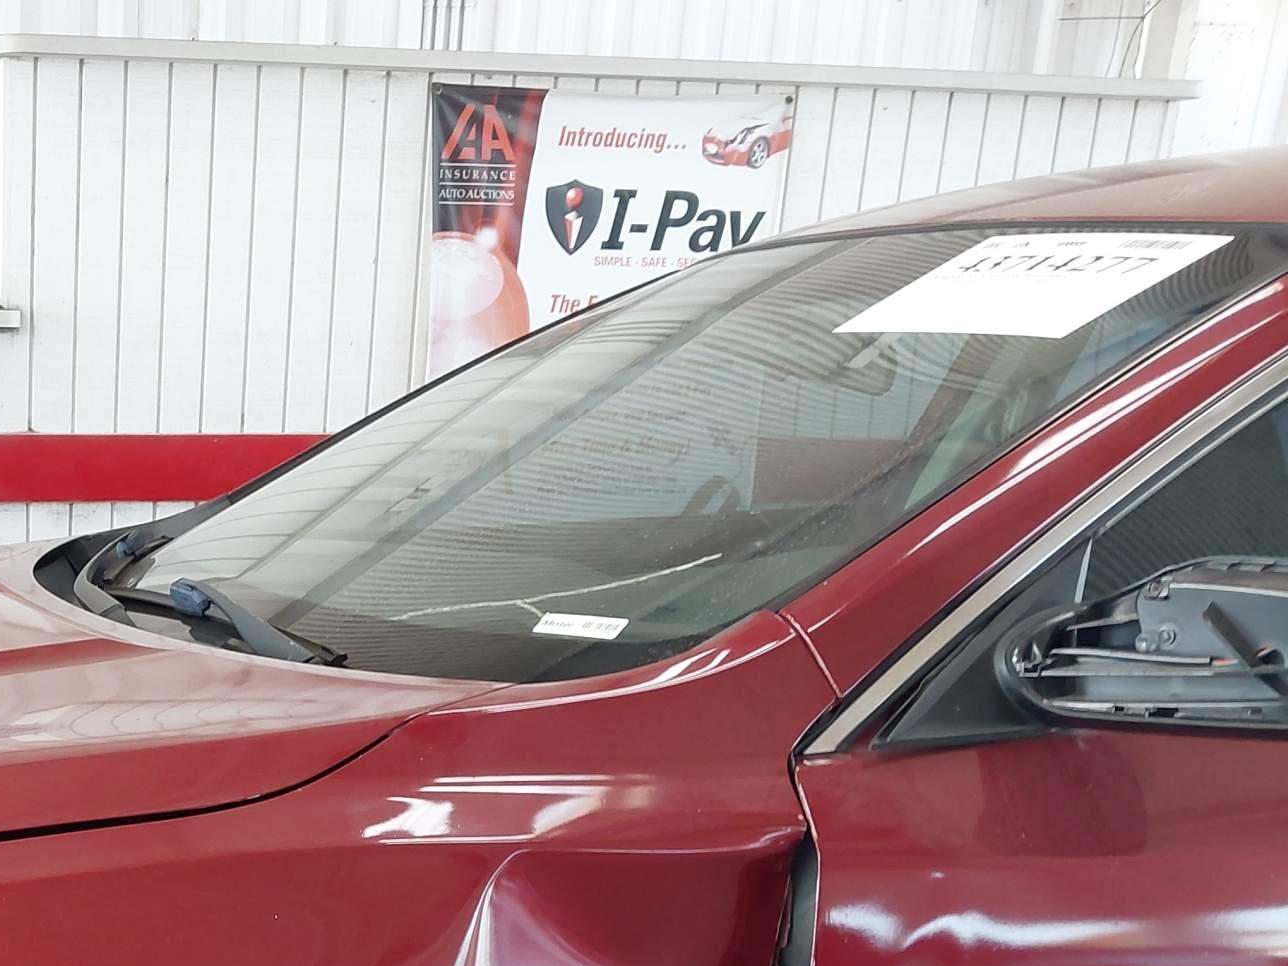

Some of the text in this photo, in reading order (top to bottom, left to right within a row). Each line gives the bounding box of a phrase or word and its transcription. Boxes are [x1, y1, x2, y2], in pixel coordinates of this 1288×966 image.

[557, 126, 687, 154] Introducing...
[439, 168, 516, 181] INSURANCE
[438, 188, 515, 200] AUTO AUCTIONS
[593, 256, 632, 267] SIMPLE
[641, 257, 667, 268] SAFE
[550, 294, 581, 313] The
